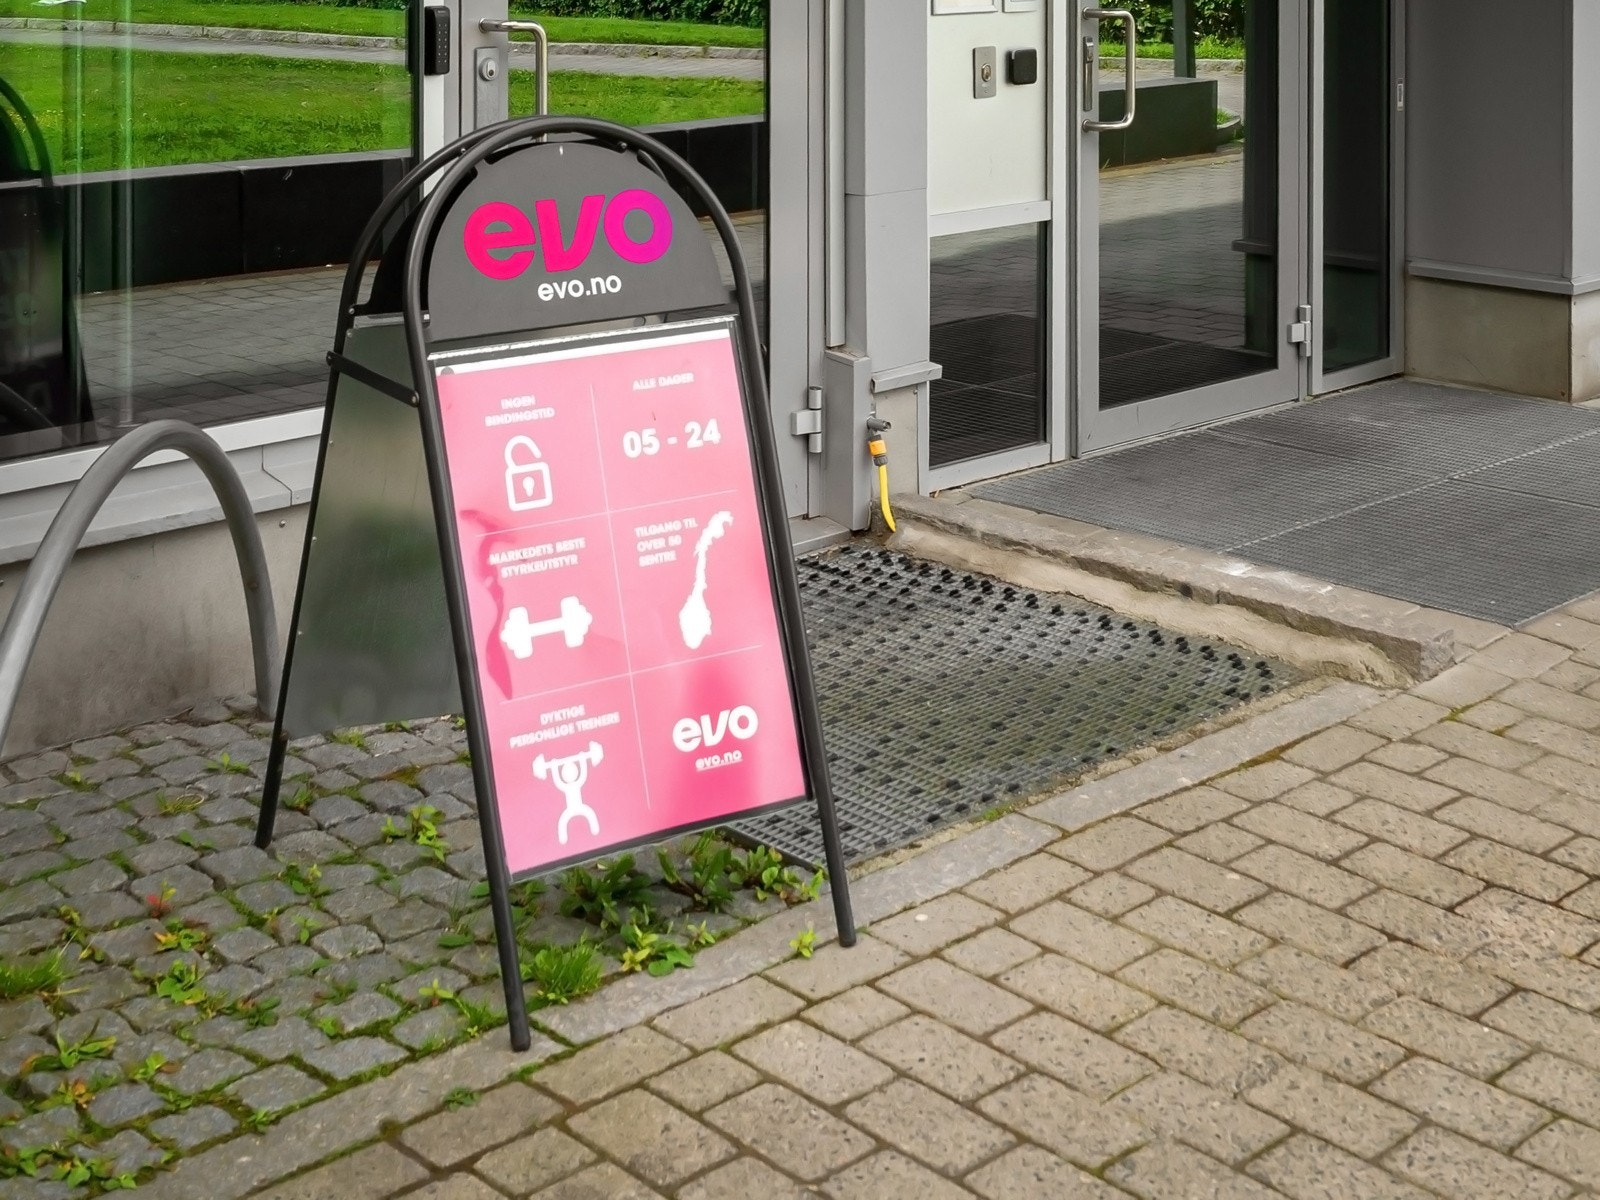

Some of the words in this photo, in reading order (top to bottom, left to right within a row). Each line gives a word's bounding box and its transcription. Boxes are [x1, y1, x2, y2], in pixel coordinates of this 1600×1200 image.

[463, 188, 673, 280] evo
[537, 275, 622, 301] evo.no
[633, 376, 656, 390] ALLE
[658, 373, 694, 387] DAGER
[501, 395, 535, 410] INGEN
[485, 407, 555, 427] BINDINGSTID
[622, 428, 660, 459] 05
[685, 418, 721, 448] 24
[634, 521, 682, 538] TILGANG
[683, 517, 698, 528] TIL
[489, 545, 554, 565] MARKEDETS
[556, 537, 586, 552] BESTE
[637, 537, 666, 553] OVER
[501, 554, 578, 578] STYRKEUTSTYR
[639, 550, 677, 567] SENTRE
[540, 704, 586, 726] DYKTIGE
[509, 723, 575, 749] PERSONLIGE
[576, 711, 621, 732] TRENERE
[672, 705, 759, 753] evo
[695, 749, 743, 771] evo.no
